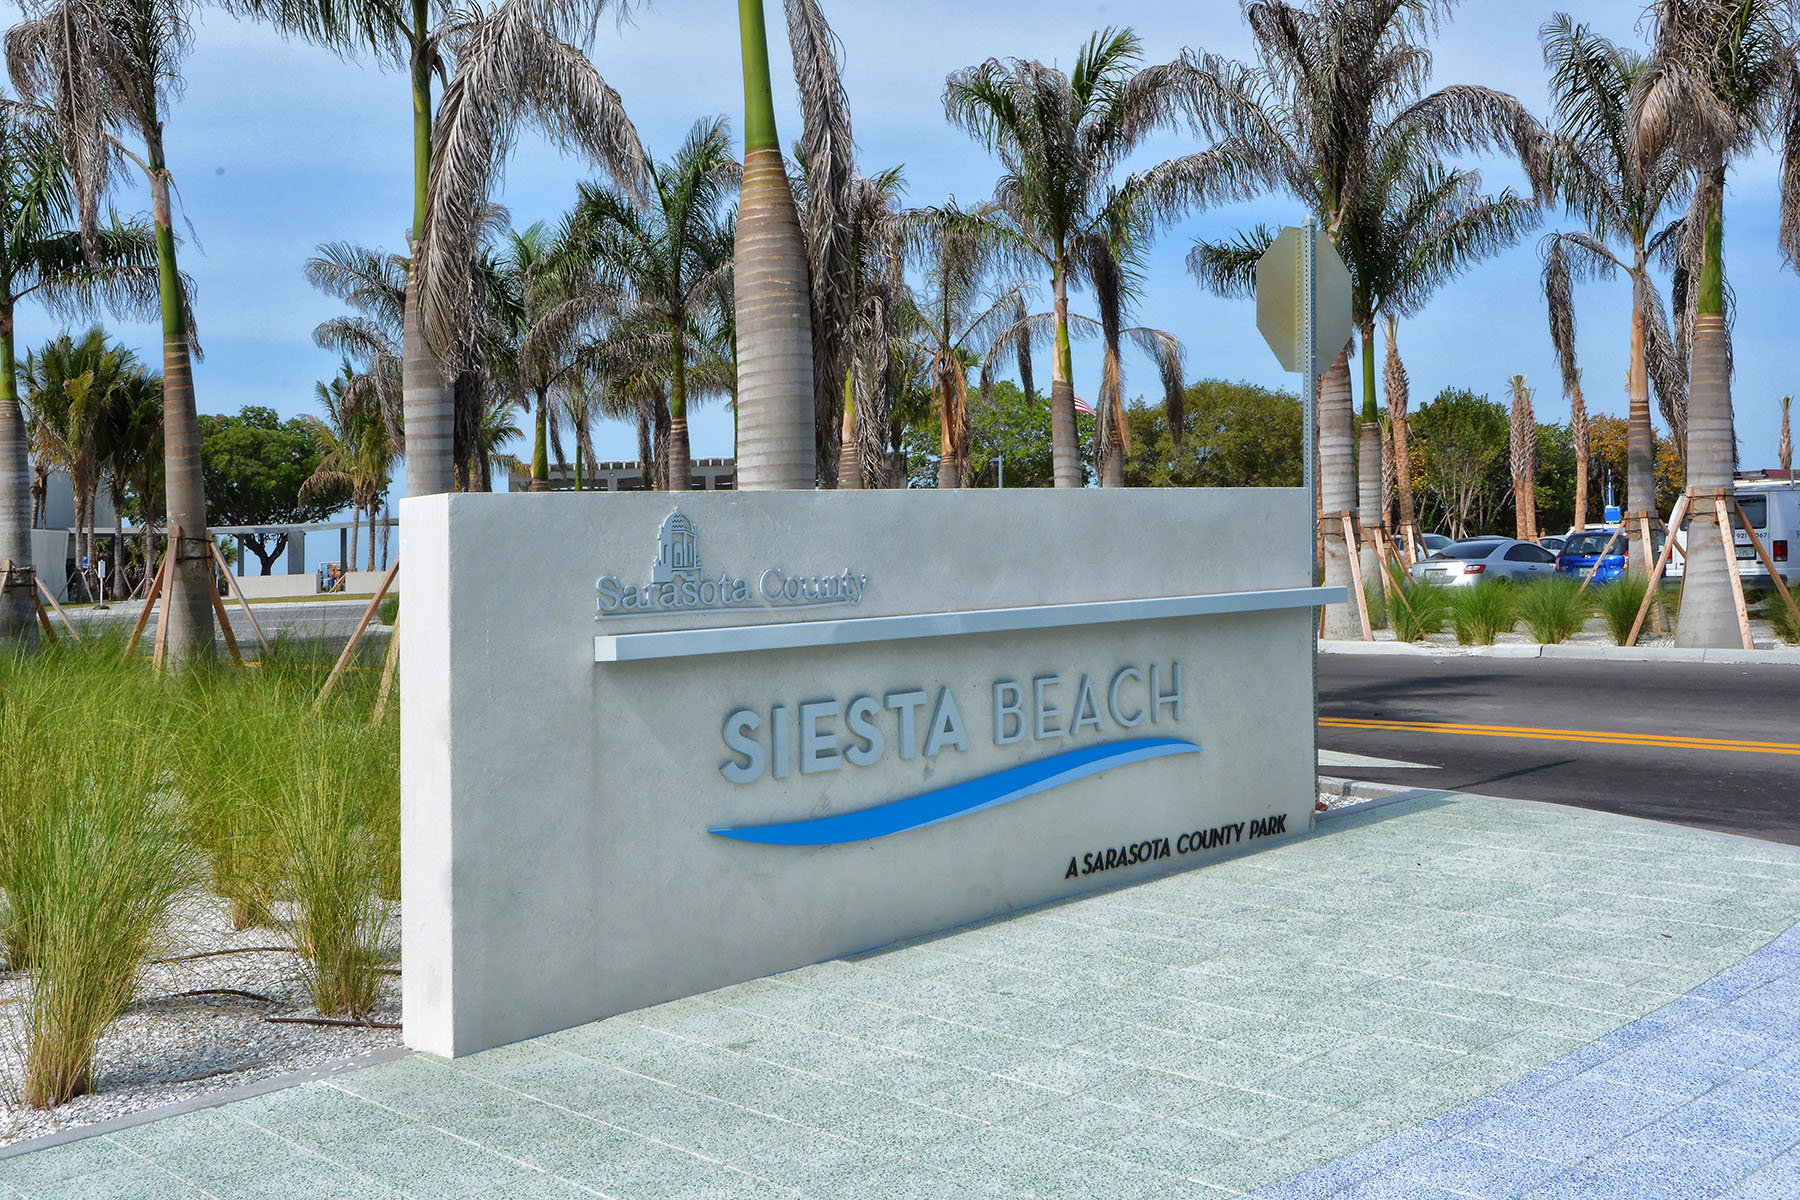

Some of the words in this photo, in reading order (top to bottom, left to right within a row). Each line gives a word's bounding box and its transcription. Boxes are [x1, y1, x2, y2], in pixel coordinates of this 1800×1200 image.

[596, 573, 751, 612] Sarasota
[759, 567, 869, 605] County
[719, 686, 970, 785] SIESTA
[993, 661, 1184, 746] BEACH
[1065, 856, 1079, 880] A
[1082, 837, 1171, 876] SARASOTA
[1176, 822, 1246, 855] COUNTY
[1249, 813, 1288, 841] PARK
